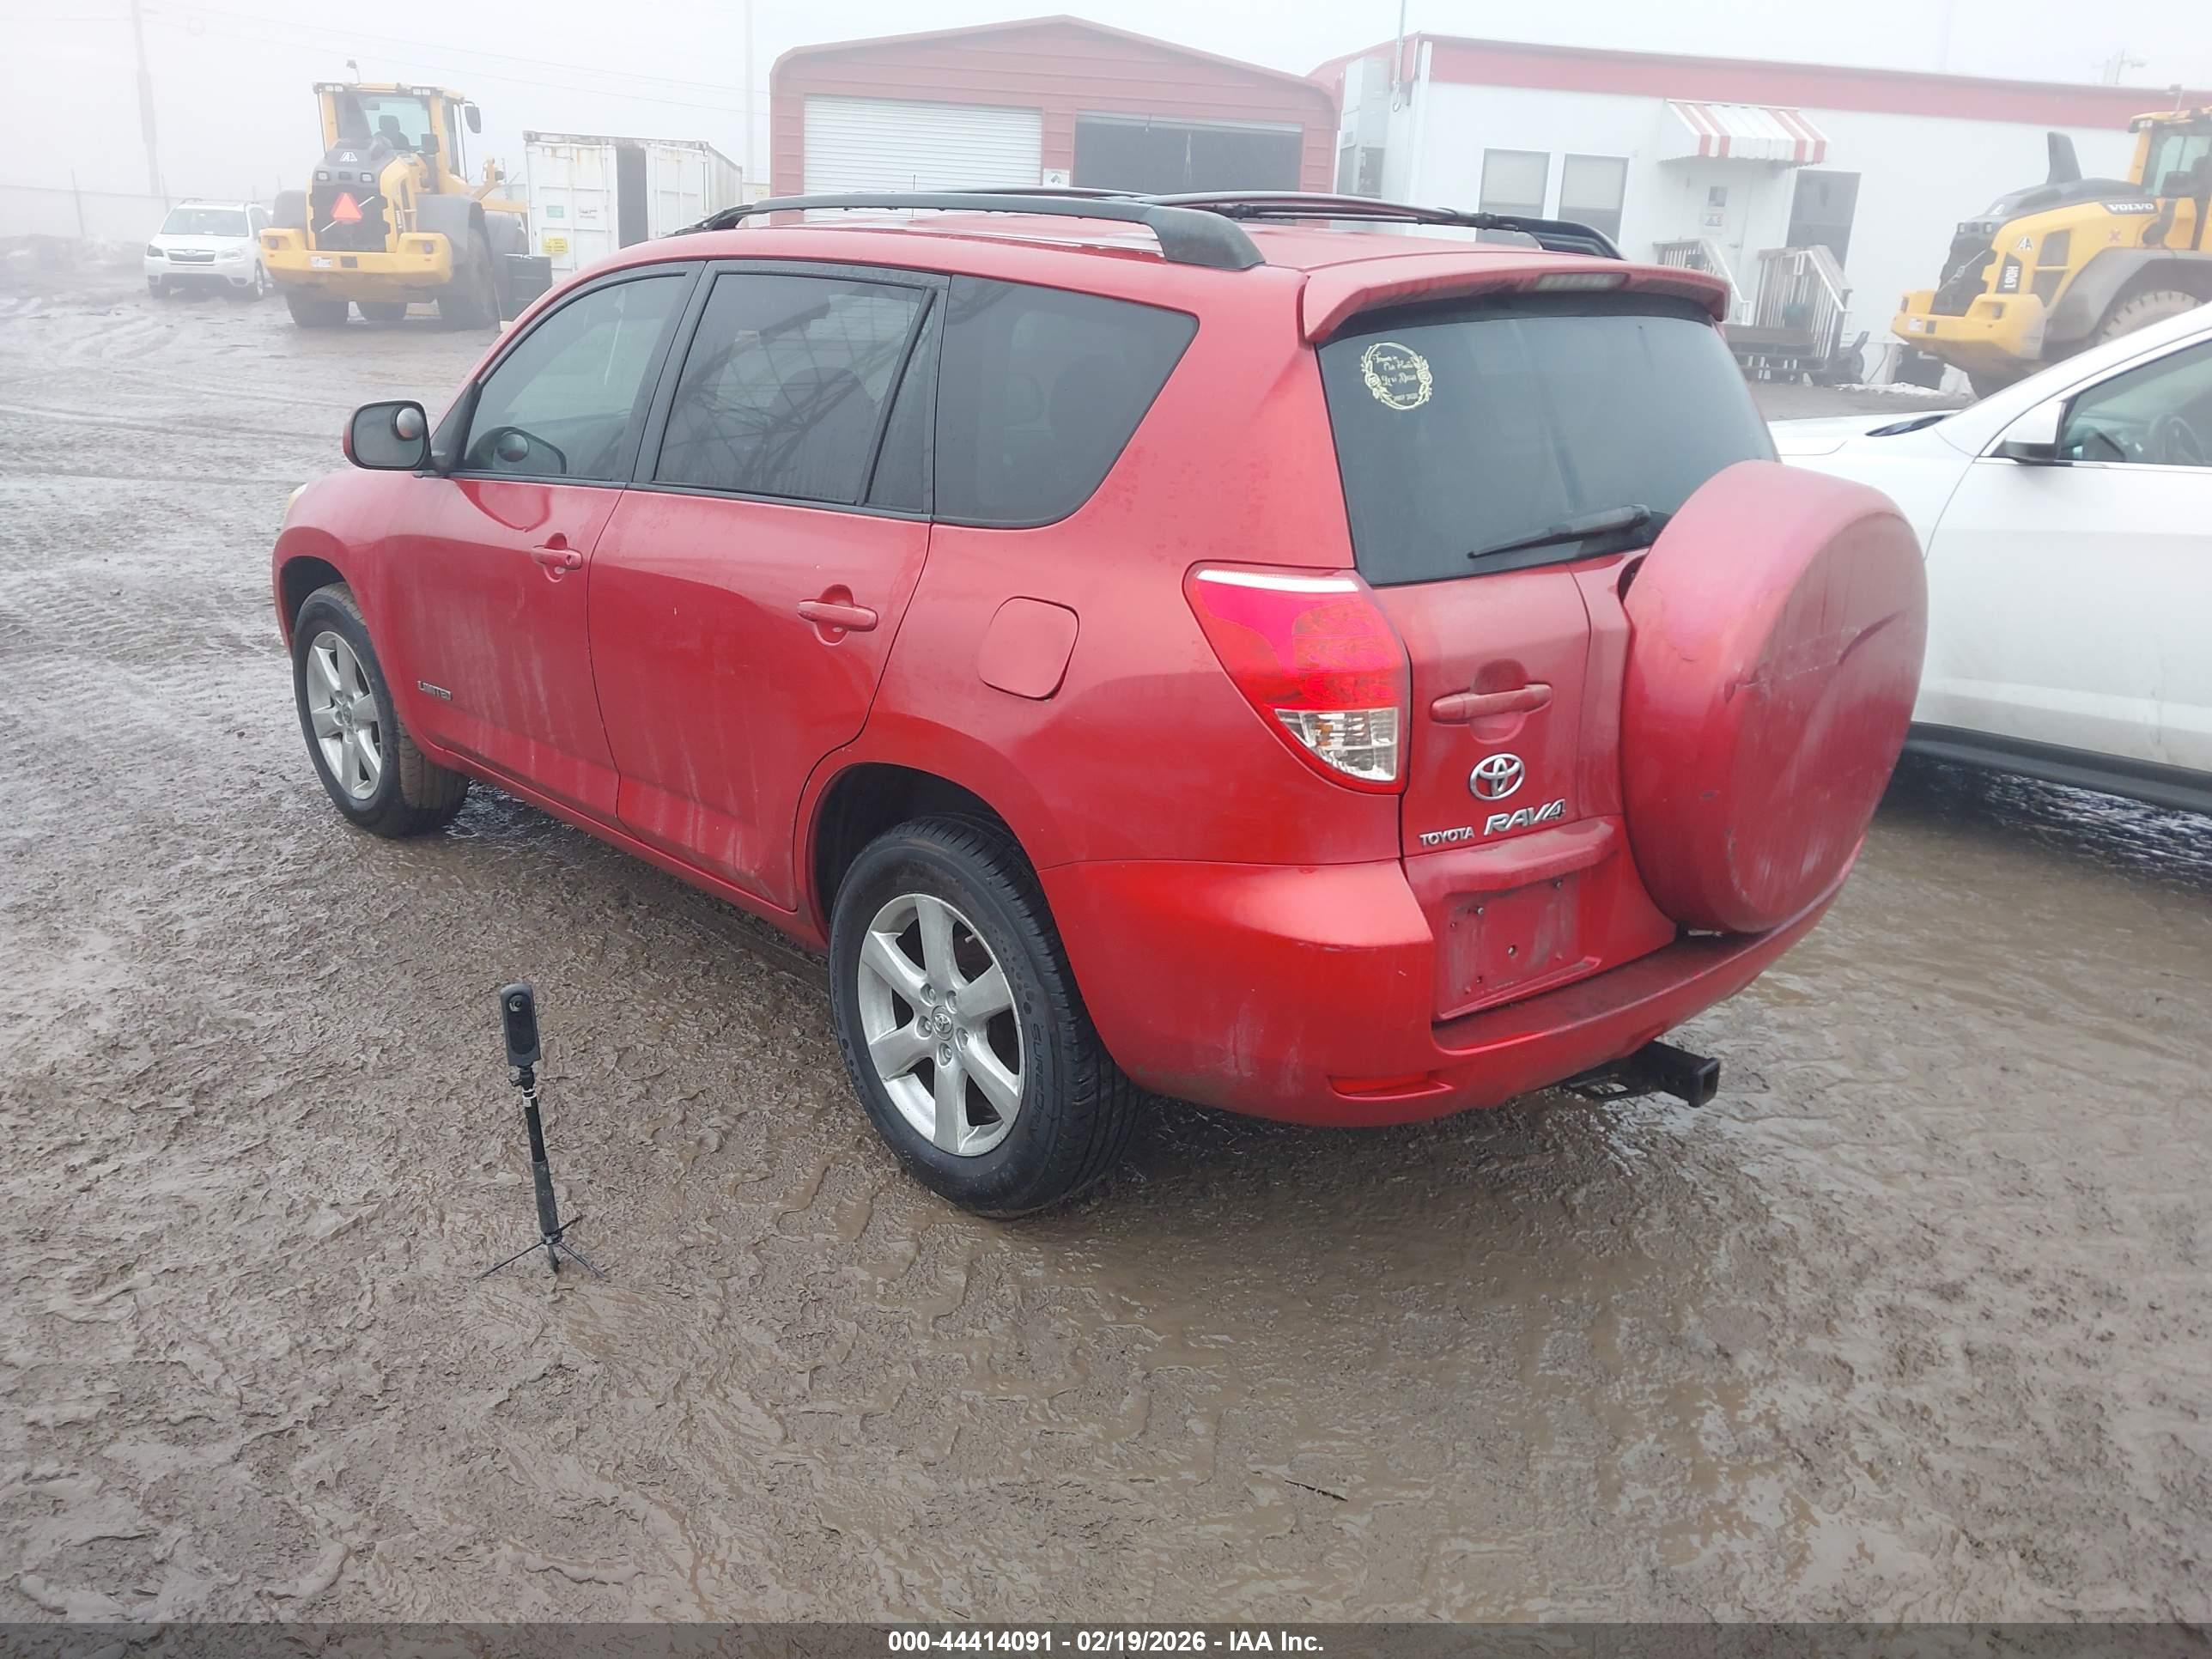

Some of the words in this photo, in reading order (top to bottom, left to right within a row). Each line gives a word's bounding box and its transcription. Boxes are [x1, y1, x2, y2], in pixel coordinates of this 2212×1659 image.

[2107, 203, 2154, 211] VOLVO
[1419, 826, 1475, 846] TOYOTA
[1483, 798, 1566, 836] RAV4
